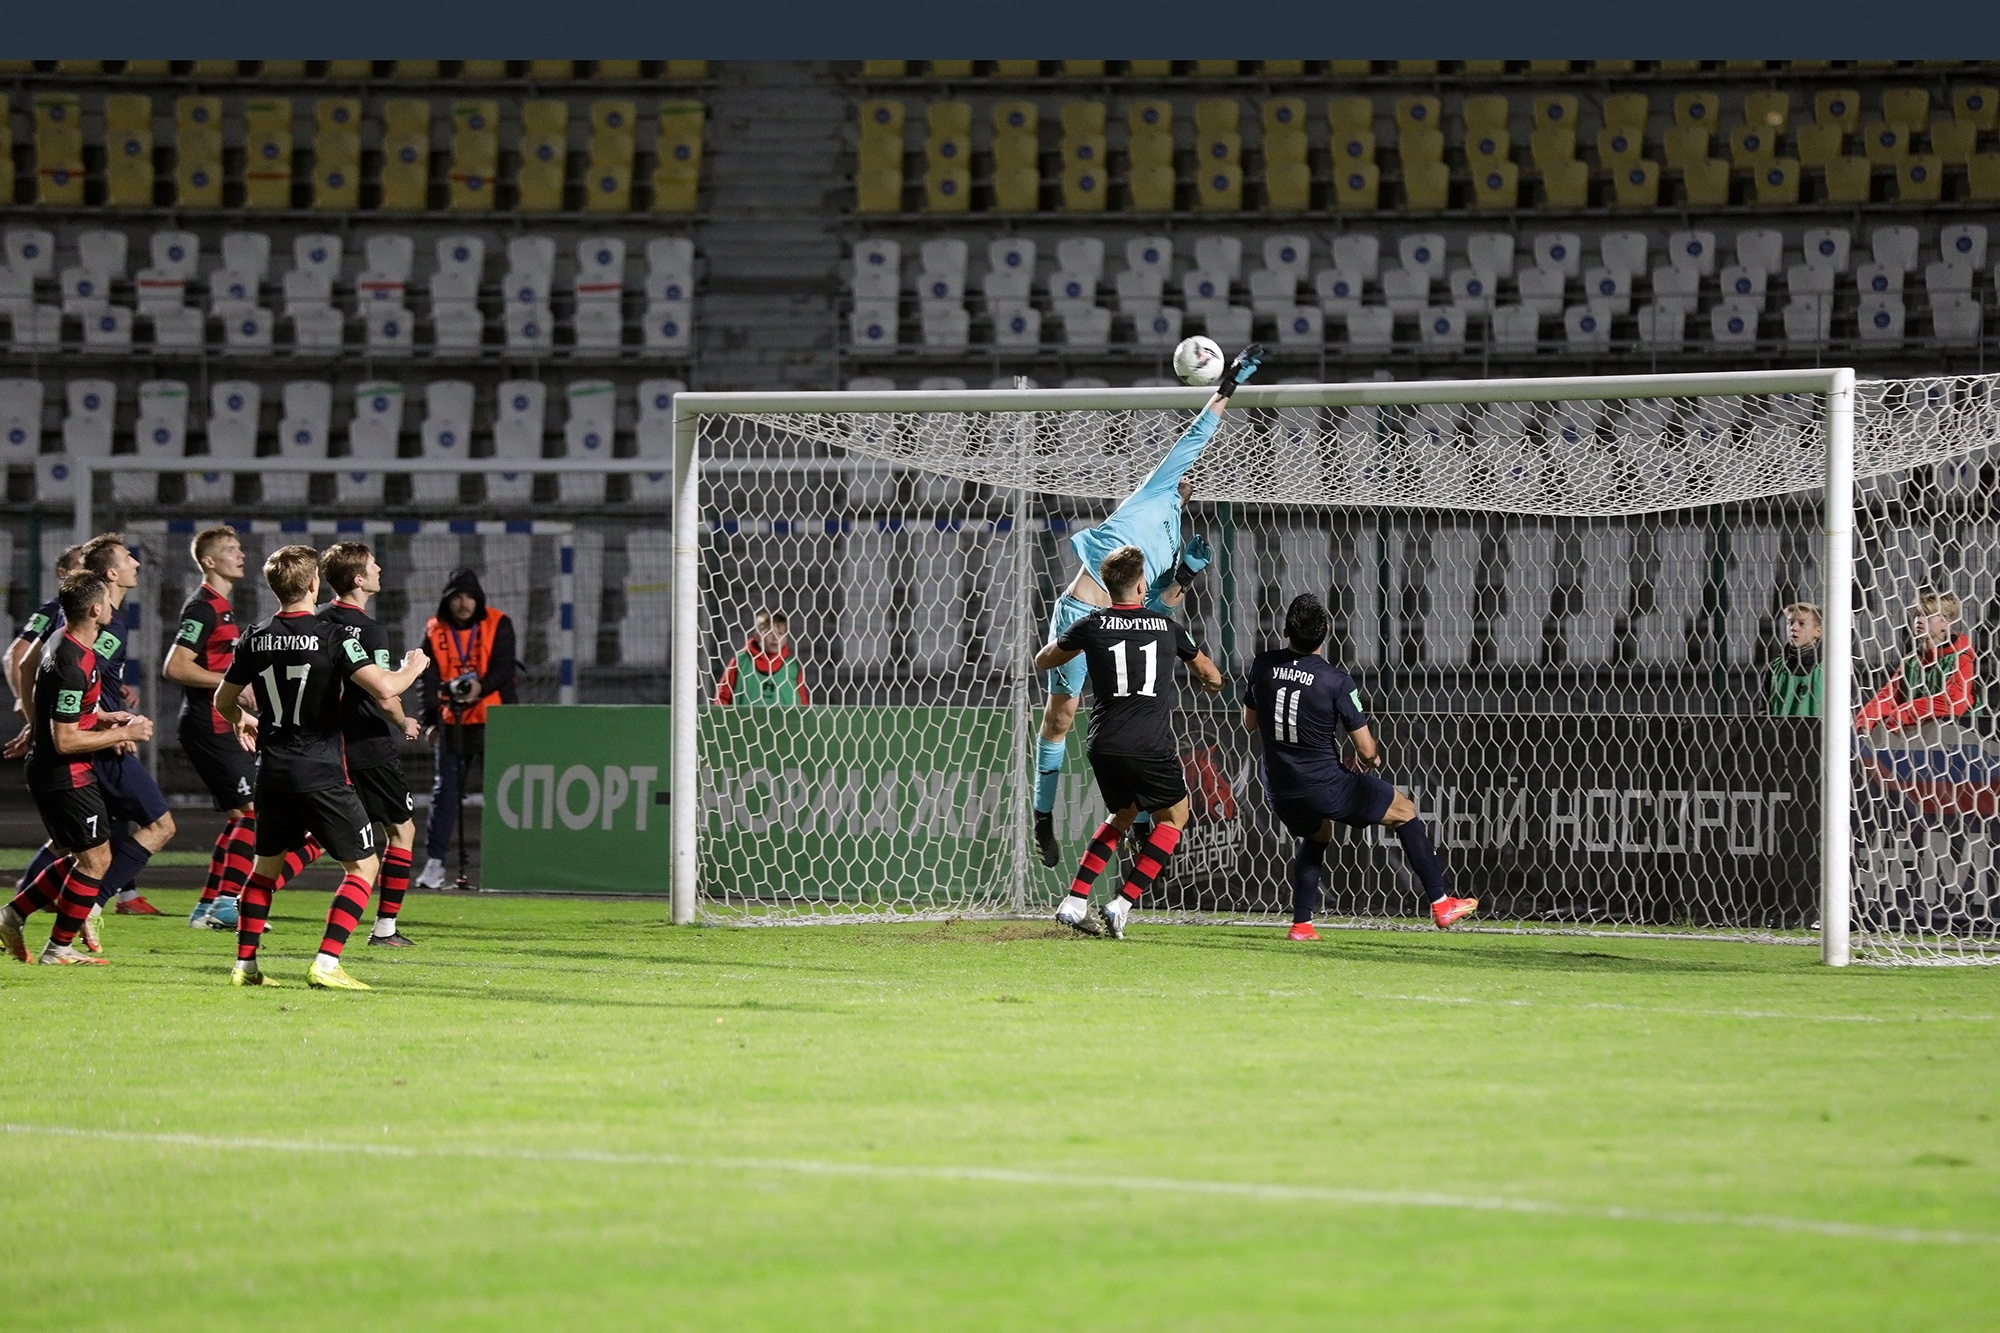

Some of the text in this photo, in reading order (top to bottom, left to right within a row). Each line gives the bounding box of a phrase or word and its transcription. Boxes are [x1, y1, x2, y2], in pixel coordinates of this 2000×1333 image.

[1099, 615, 1169, 632] ЗАБОТКИН
[250, 633, 320, 652] ГАЙДУКОВ
[1107, 639, 1158, 698] 11
[1272, 666, 1315, 687] УМАРОВ
[258, 662, 312, 728] 17
[1274, 686, 1301, 743] 11
[236, 776, 252, 796] 4
[405, 791, 414, 811] 6
[86, 814, 99, 838] 7
[1549, 788, 1792, 856] НОСОРОГ
[359, 821, 375, 850] 17
